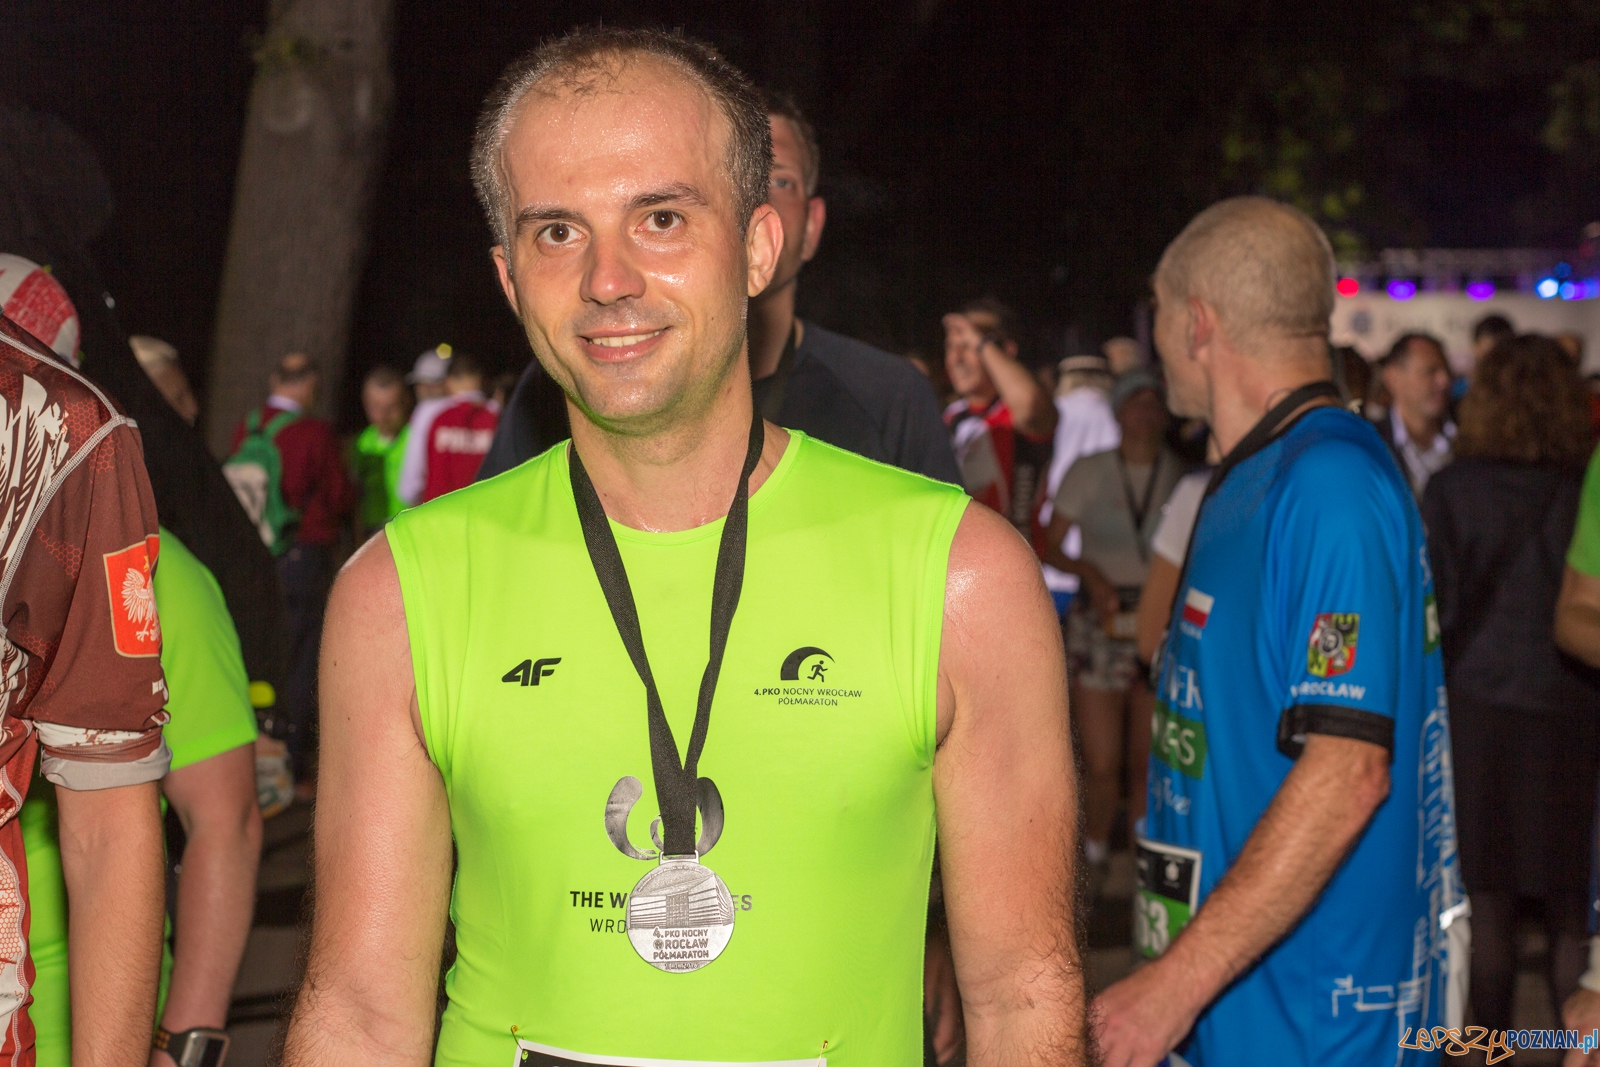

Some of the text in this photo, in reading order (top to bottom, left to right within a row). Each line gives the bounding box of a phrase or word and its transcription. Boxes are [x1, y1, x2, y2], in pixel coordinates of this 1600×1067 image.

[501, 657, 562, 687] 4F
[782, 687, 815, 696] NOCNY
[817, 688, 863, 698] WROCŁAW
[778, 696, 838, 707] PÓŁMARATON
[569, 890, 605, 909] THE
[682, 928, 709, 938] NOCNY
[652, 949, 709, 960] PÓŁMARATON
